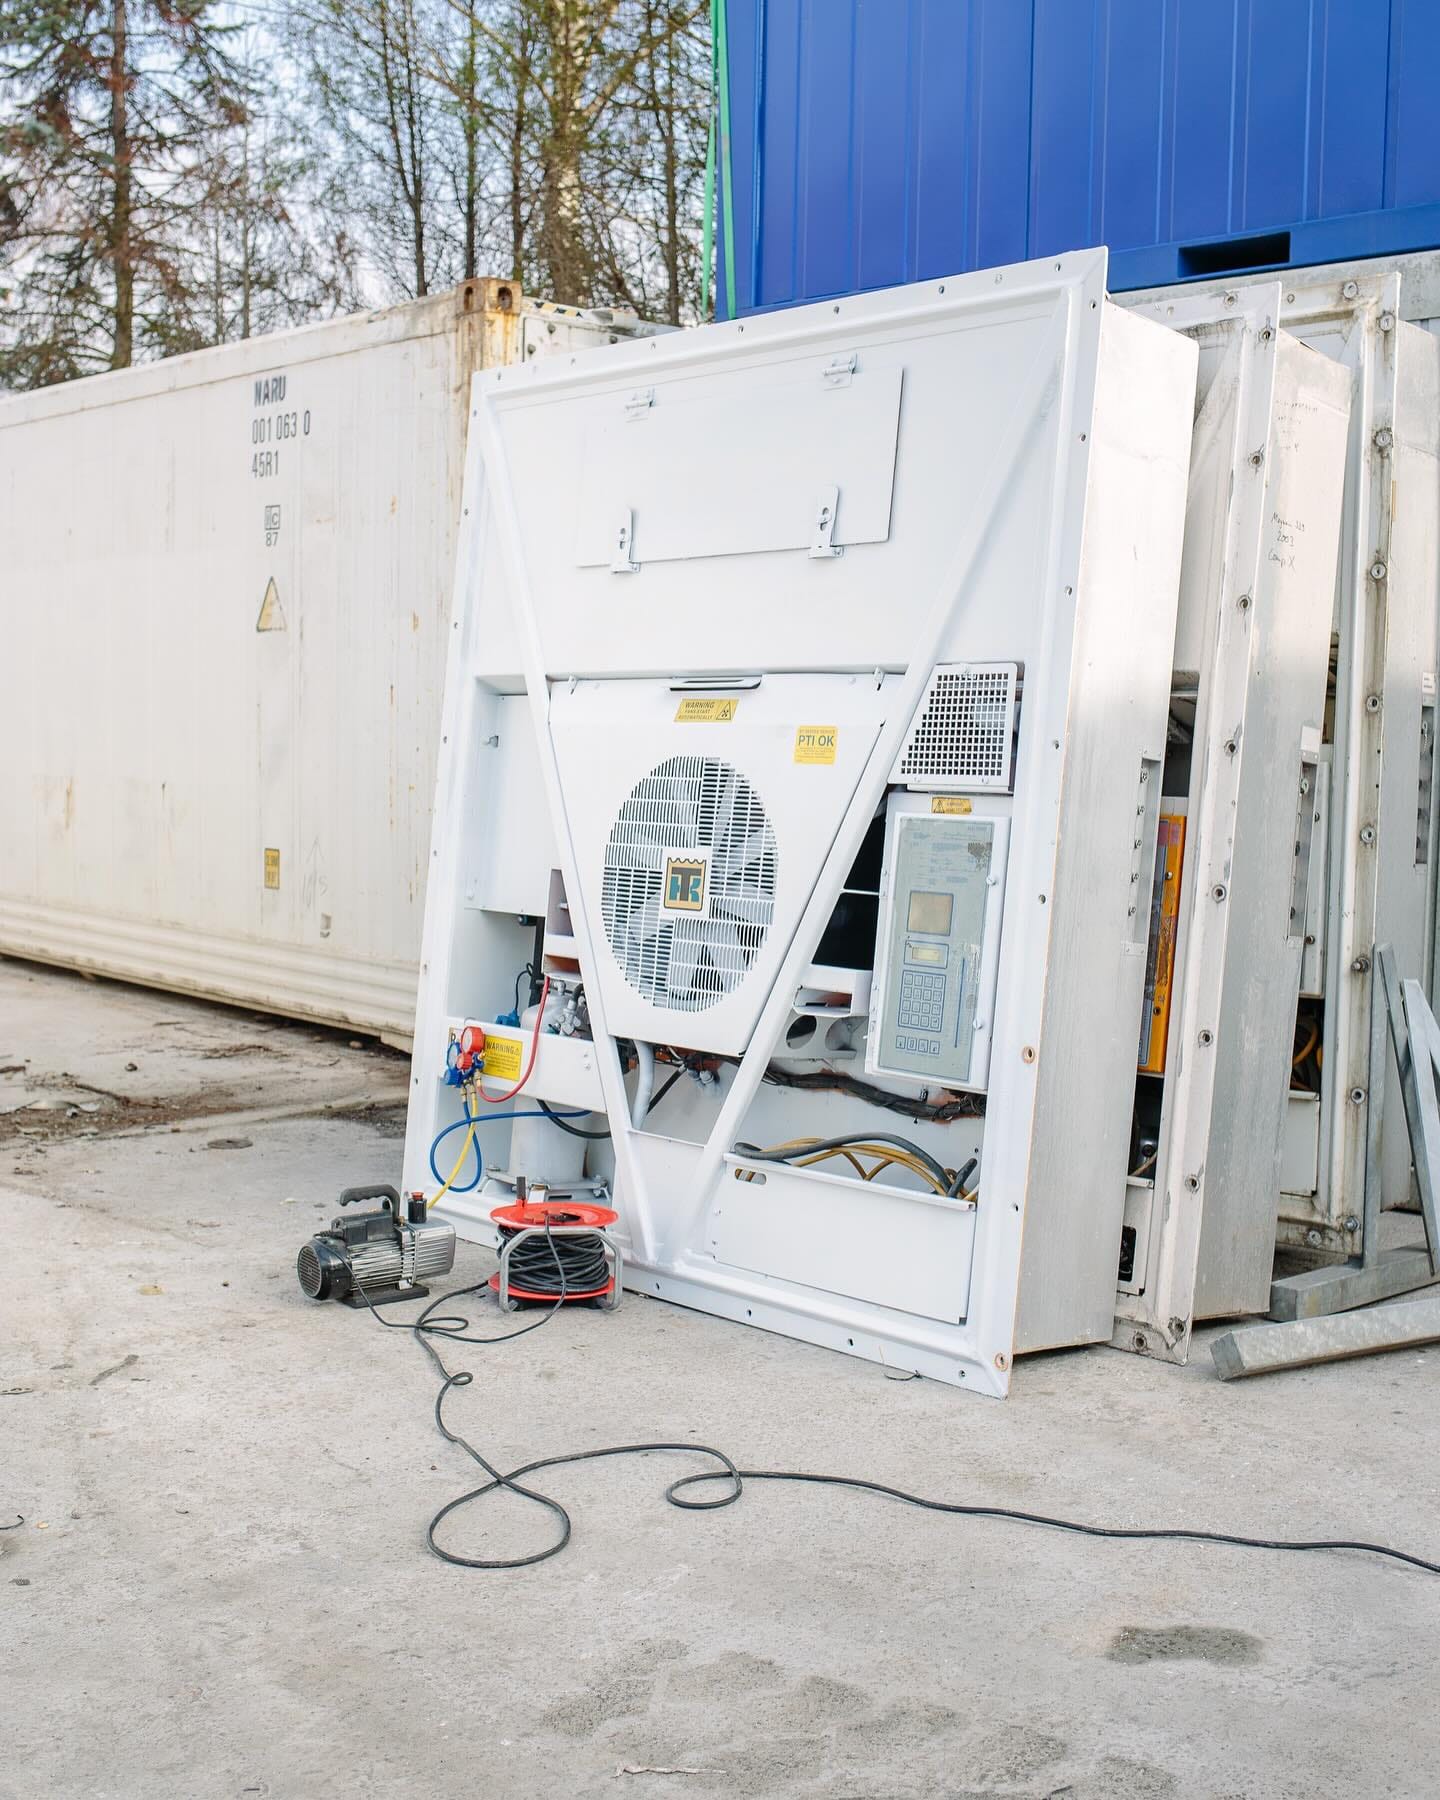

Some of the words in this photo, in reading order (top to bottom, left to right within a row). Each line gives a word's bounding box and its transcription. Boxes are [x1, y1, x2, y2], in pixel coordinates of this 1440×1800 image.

[254, 376, 286, 407] NARU
[252, 416, 271, 444] 001
[276, 412, 297, 440] 063
[303, 409, 310, 436] 0
[252, 449, 278, 478] 45R1
[265, 531, 279, 547] 87
[798, 734, 815, 747] PTI
[818, 734, 834, 747] OK
[486, 1041, 515, 1054] WARNING
